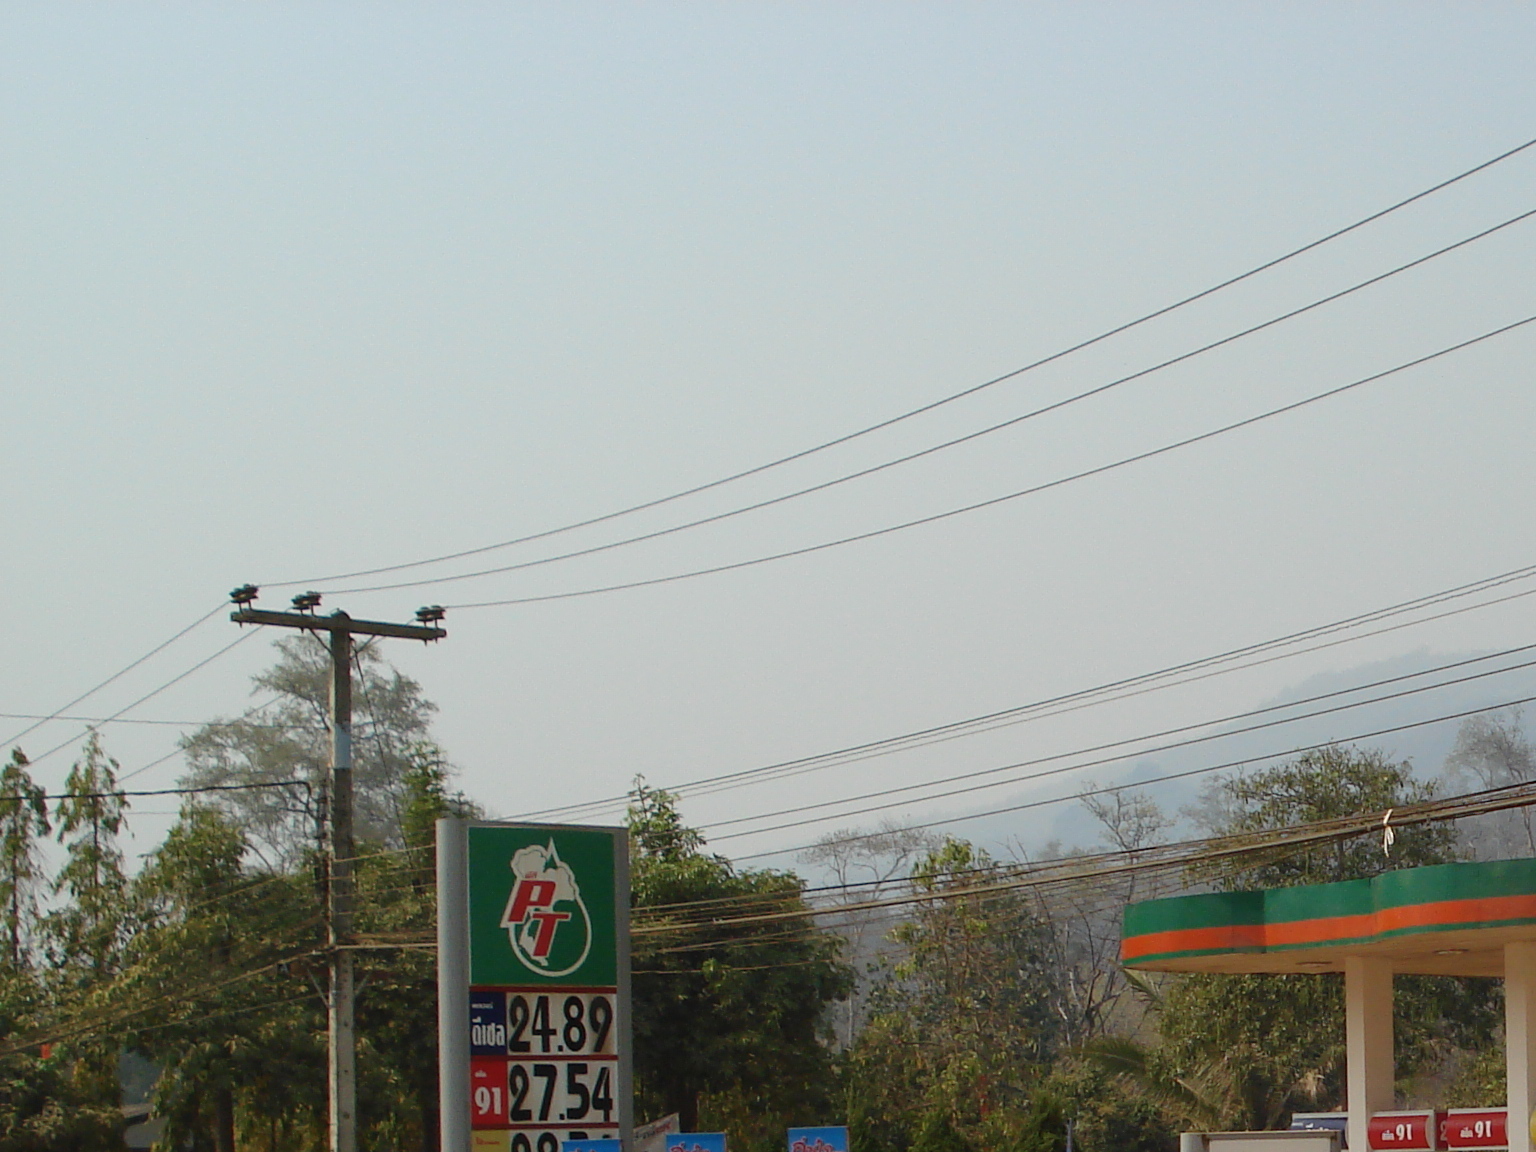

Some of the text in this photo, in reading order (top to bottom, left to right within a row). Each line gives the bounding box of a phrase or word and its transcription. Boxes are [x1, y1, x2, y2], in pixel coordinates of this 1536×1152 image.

[507, 880, 571, 957] PT
[509, 995, 613, 1052] 24.89
[475, 1063, 613, 1122] 91 27.54
[1396, 1123, 1412, 1141] 91
[1474, 1120, 1492, 1138] 91
